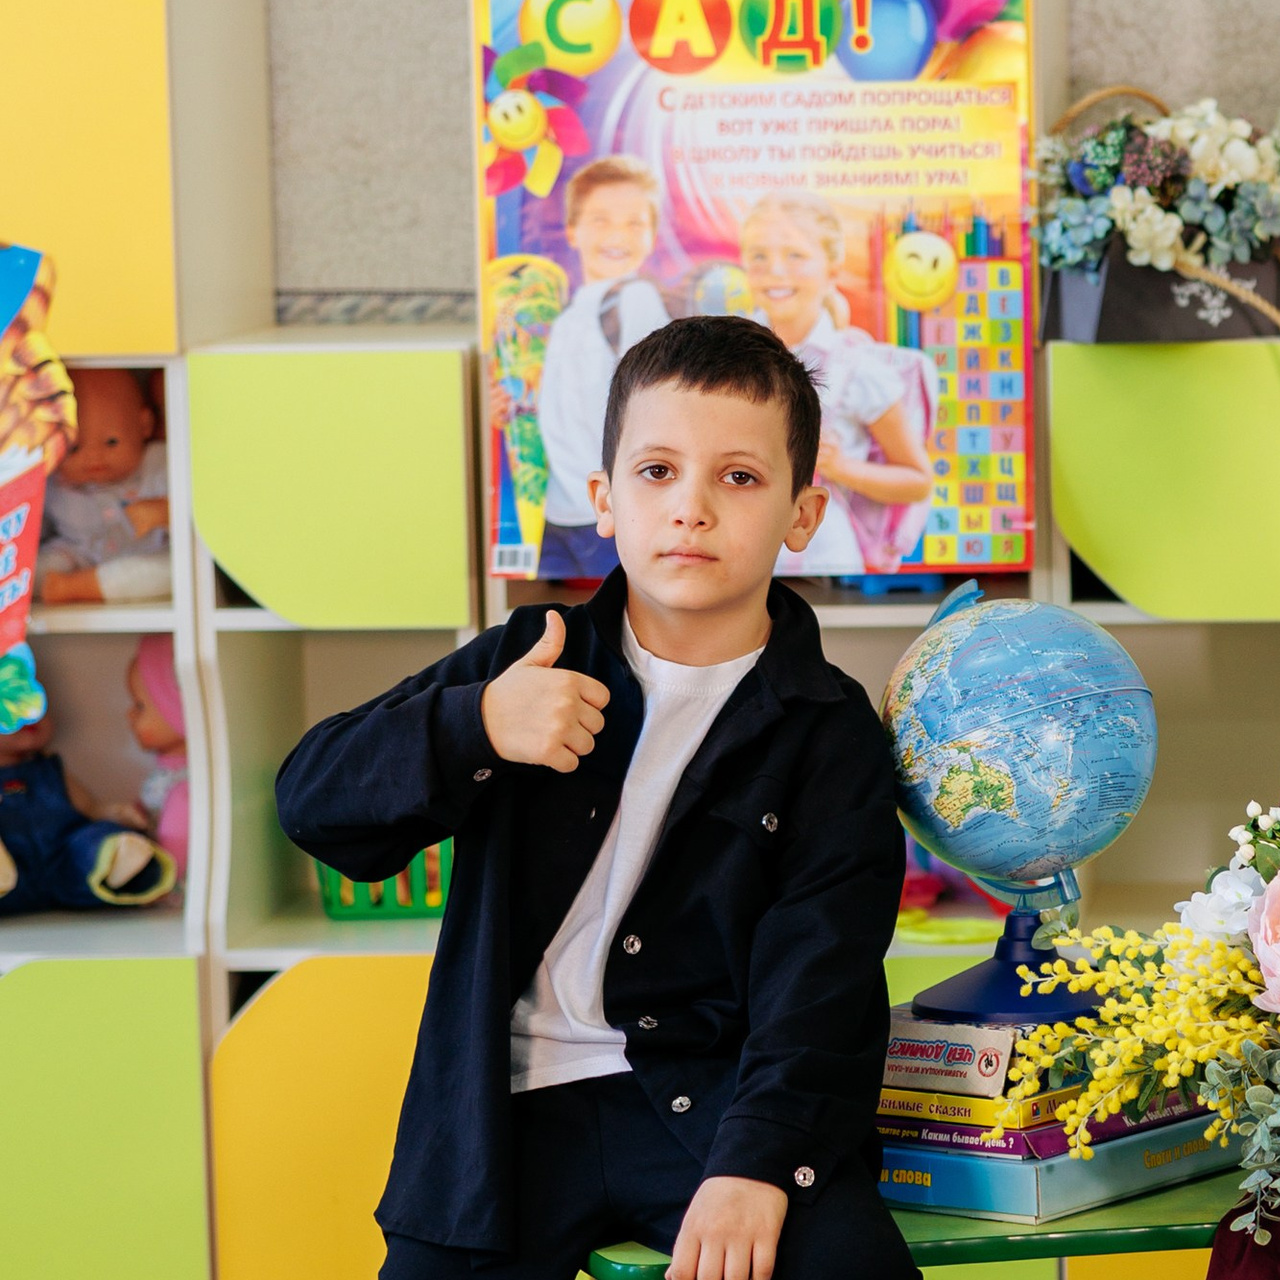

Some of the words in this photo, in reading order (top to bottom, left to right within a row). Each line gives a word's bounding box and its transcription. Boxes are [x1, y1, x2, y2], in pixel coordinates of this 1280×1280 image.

[659, 86, 675, 111] С
[998, 268, 1010, 286] В
[965, 294, 979, 315] Д
[964, 323, 982, 341] Ж
[1000, 350, 1012, 368] К
[966, 378, 981, 395] М
[1001, 377, 1013, 395] Н
[967, 404, 980, 422] П
[1001, 404, 1012, 422] Р
[935, 431, 947, 450] С
[968, 431, 980, 449] Т
[1001, 433, 1013, 451] У
[934, 459, 950, 477] Ф
[967, 458, 981, 477] Х
[1000, 457, 1014, 477] Ц
[964, 485, 983, 503] Ш
[997, 484, 1017, 505] Щ
[934, 512, 949, 530] Ъ
[966, 513, 982, 529] Ы
[965, 538, 983, 555] Ю
[888, 1041, 946, 1060] ДОМИК?
[945, 1043, 974, 1063] ЧЕЙ
[920, 1127, 951, 1143] Каким
